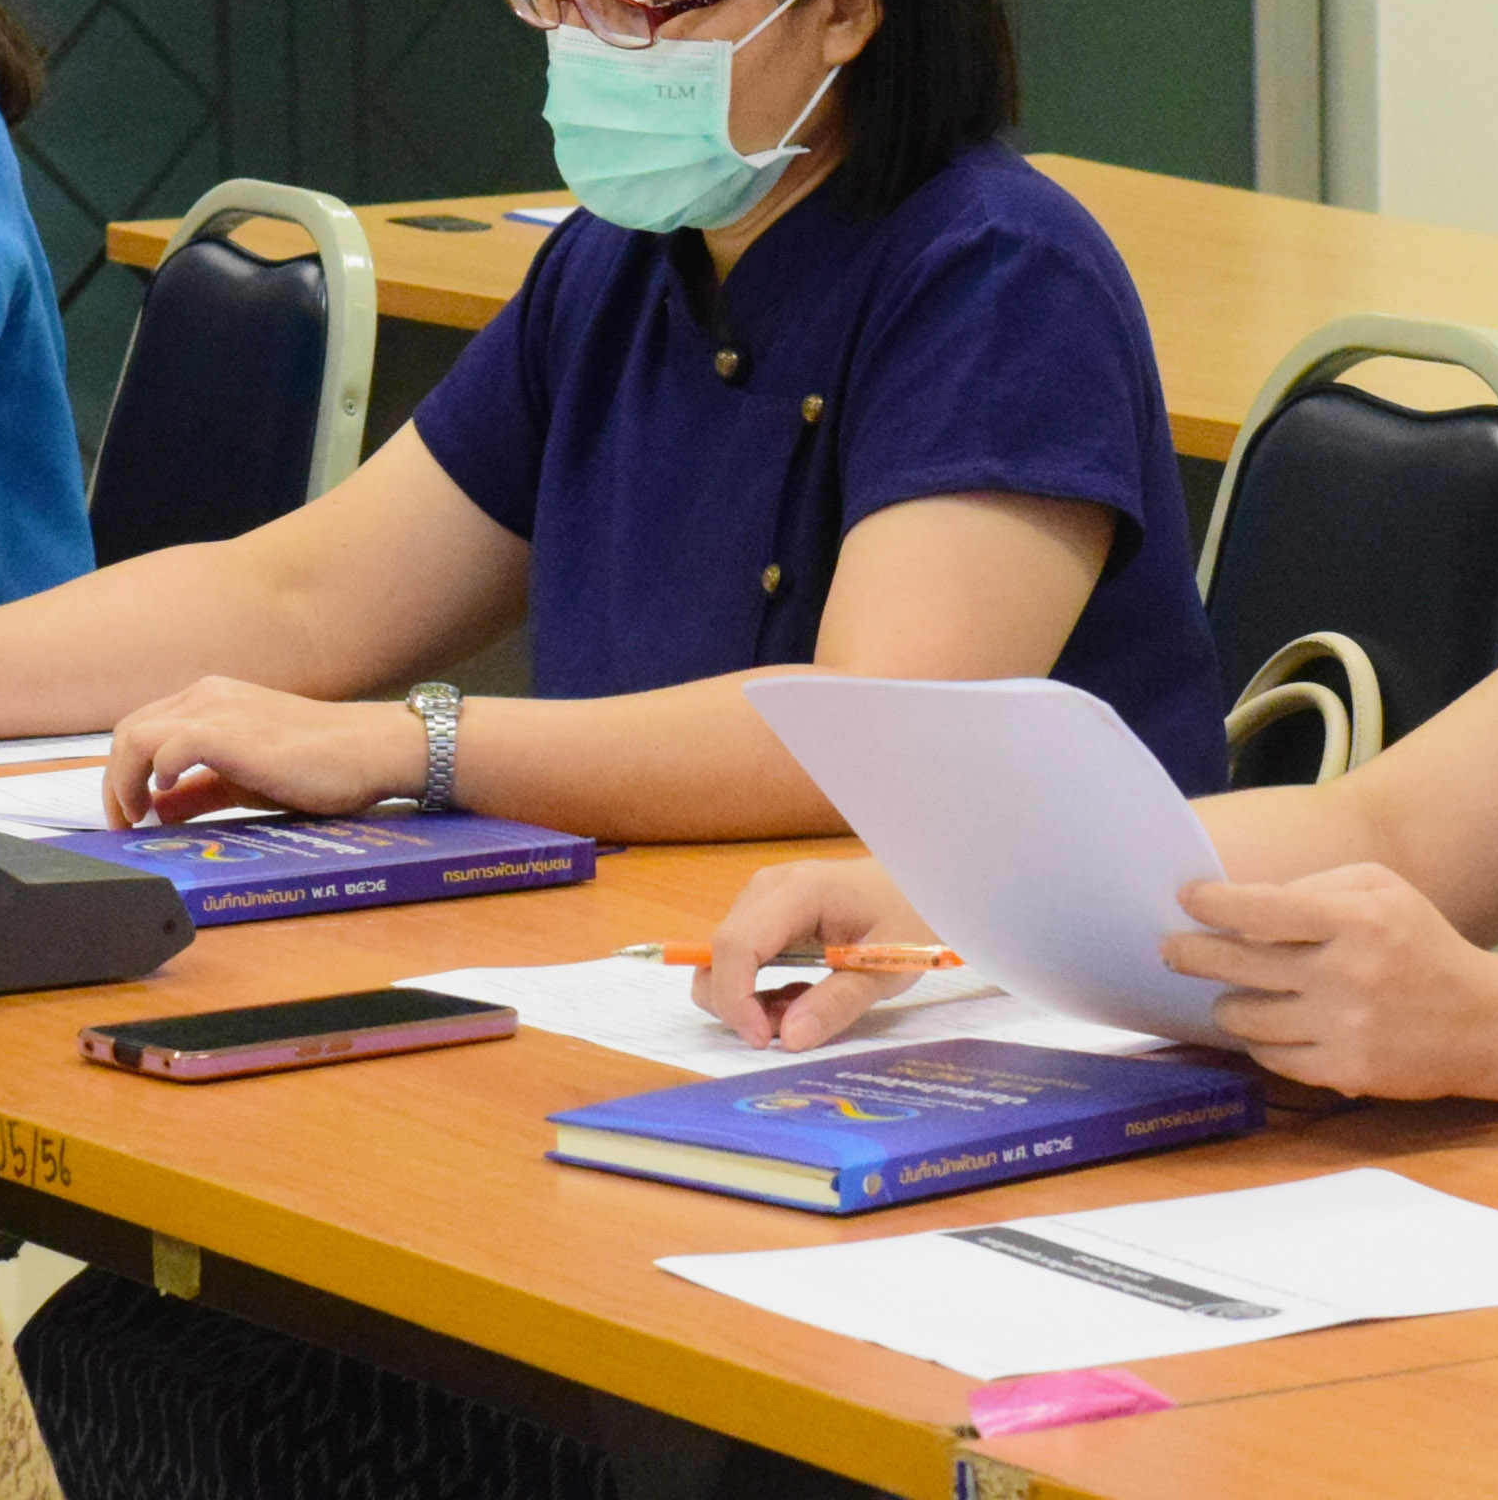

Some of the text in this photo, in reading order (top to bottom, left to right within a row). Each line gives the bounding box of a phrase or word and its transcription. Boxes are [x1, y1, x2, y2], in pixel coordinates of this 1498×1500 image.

[654, 84, 696, 100] TLM
[442, 858, 572, 883] กรมการพัฒนาชุมชน
[203, 889, 306, 912] บันทึกนักพัฒนา
